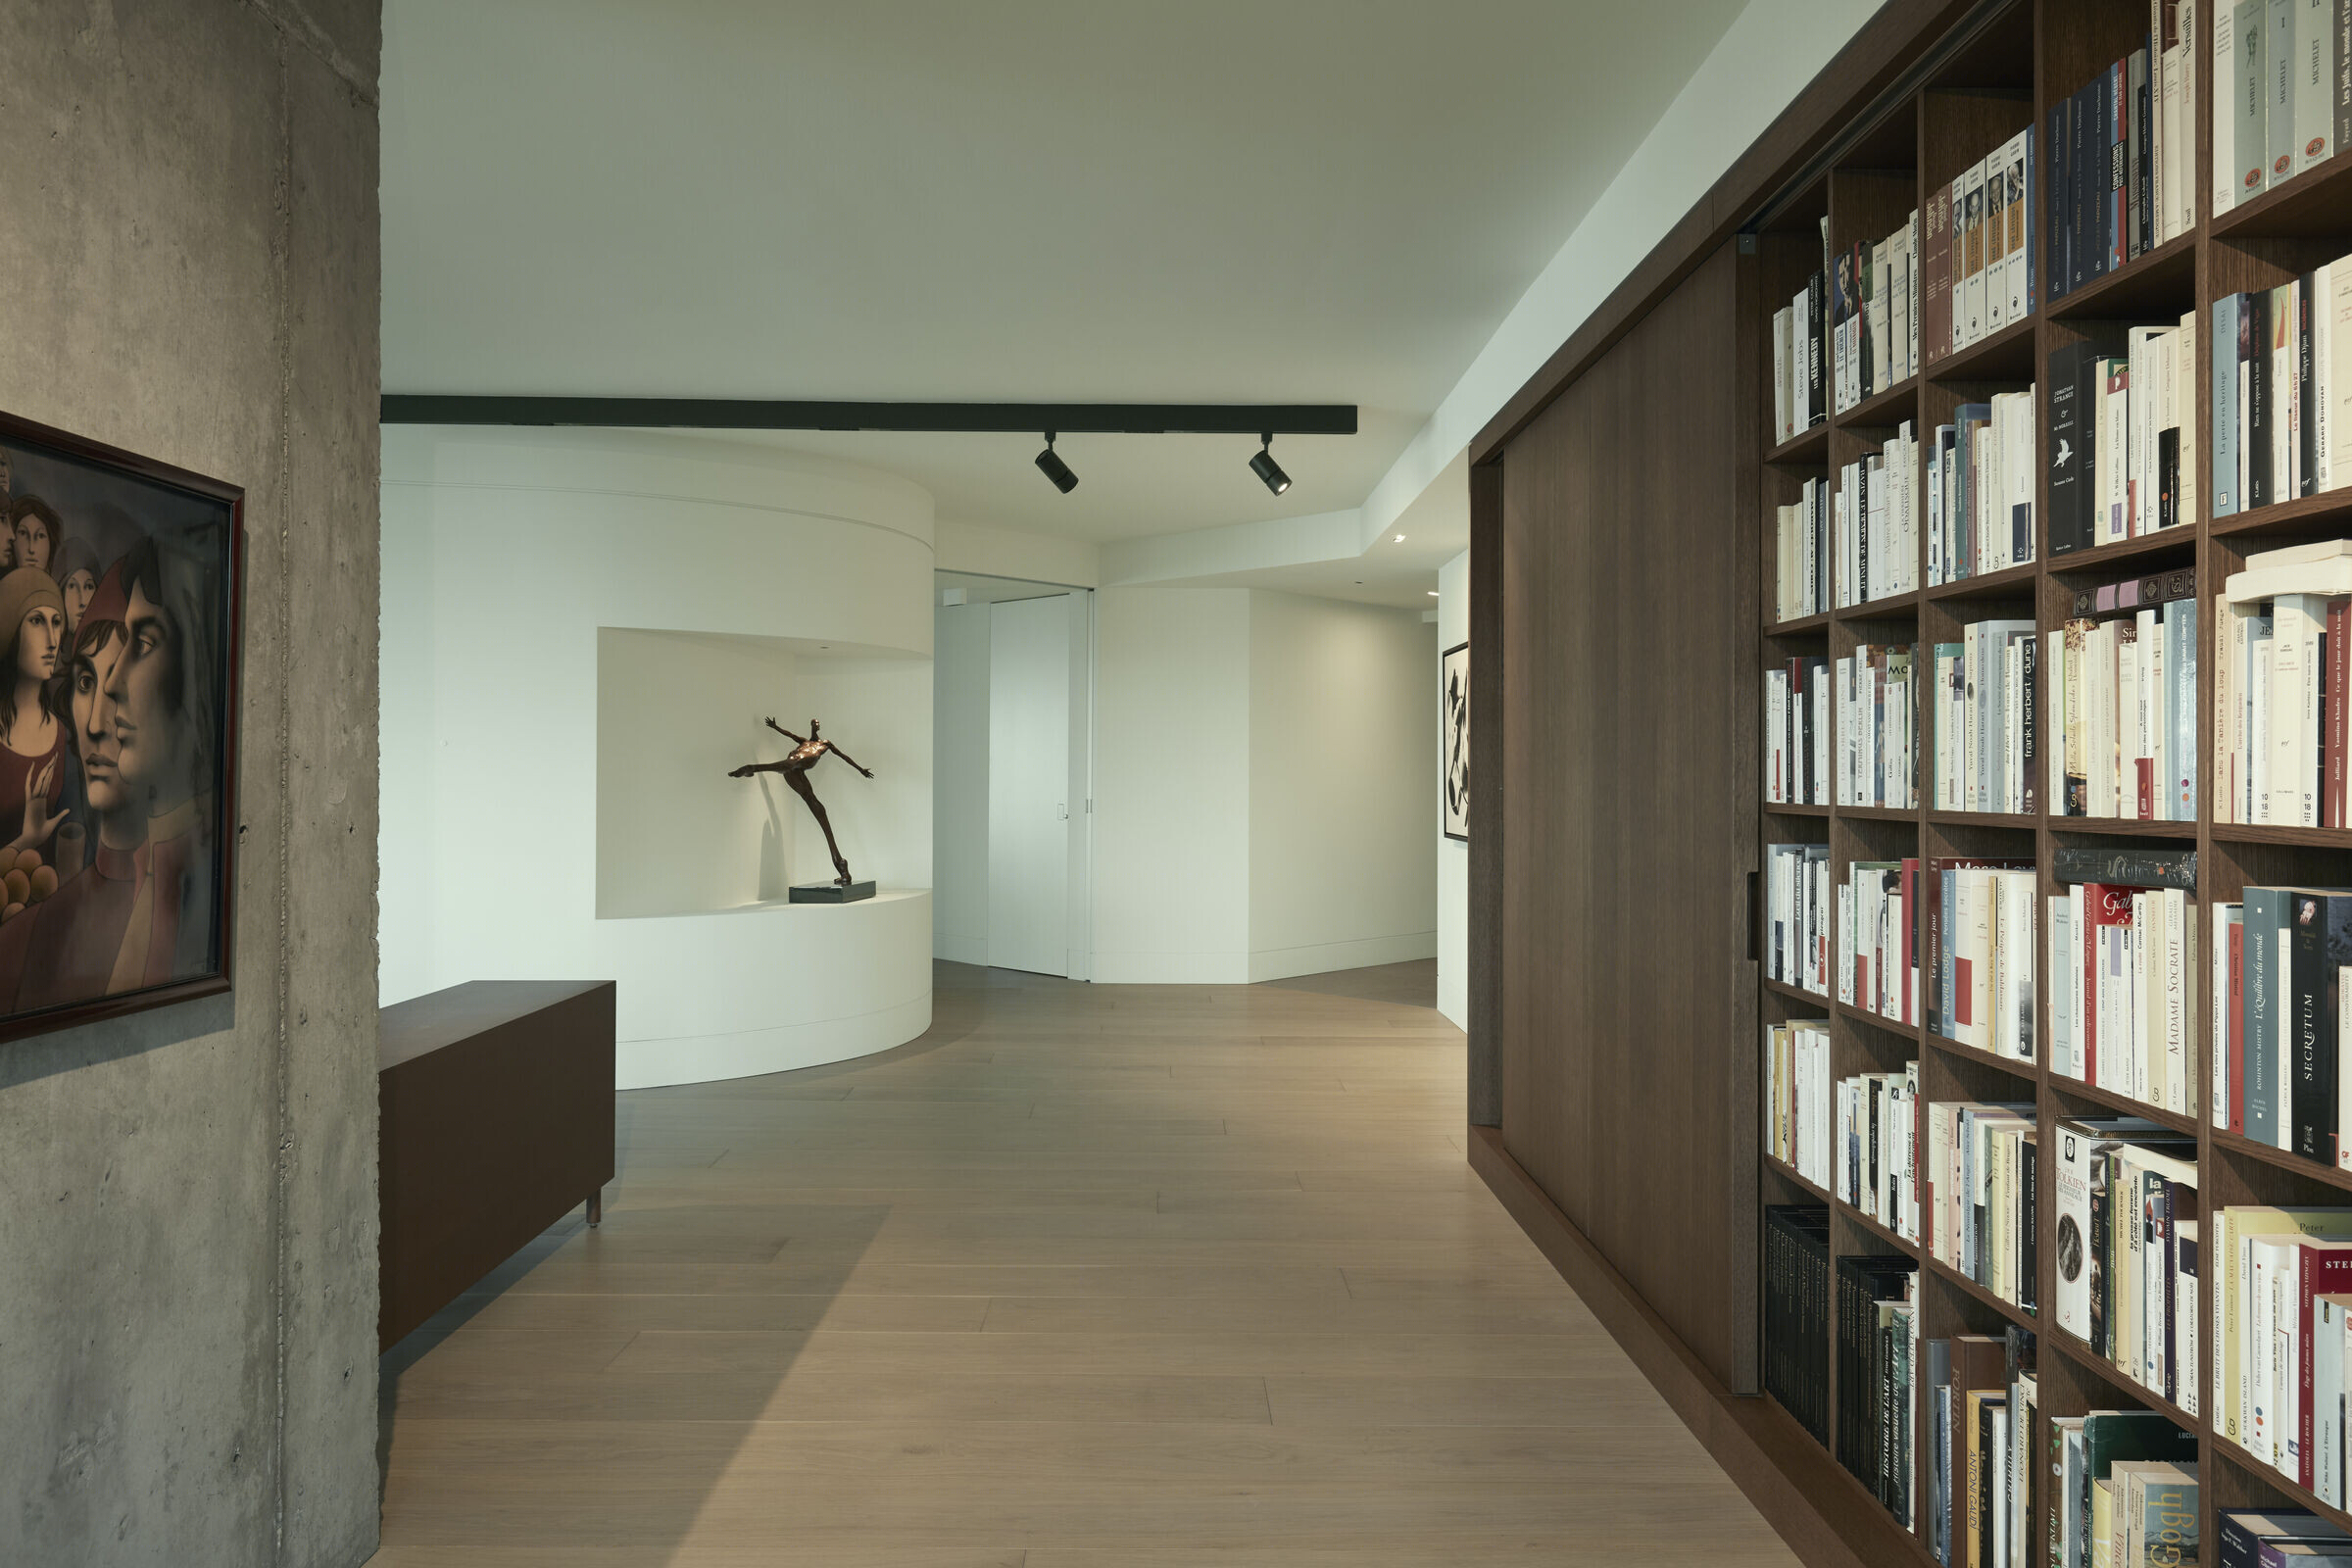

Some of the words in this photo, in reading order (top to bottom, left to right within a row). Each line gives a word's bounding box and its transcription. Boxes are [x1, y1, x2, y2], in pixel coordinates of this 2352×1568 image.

[2182, 7, 2192, 59] Versailles
[2342, 56, 2350, 65] le
[2301, 334, 2310, 354] Djian
[2301, 356, 2310, 382] Philippe
[2054, 391, 2074, 403] STRANGE
[2220, 408, 2228, 417] en
[2220, 443, 2228, 455] La
[2217, 668, 2226, 689] loup
[2335, 684, 2342, 693] Ce
[2024, 682, 2033, 725] herbert
[2217, 693, 2226, 704] du
[2217, 709, 2226, 743] Tanière
[2024, 728, 2033, 758] frank
[2217, 746, 2226, 756] la
[2217, 760, 2226, 780] Dans
[1999, 917, 2005, 927] Le
[2254, 933, 2266, 960] monde
[1942, 945, 1951, 979] Lodge
[2167, 939, 2180, 994] SOCRATE
[2254, 961, 2266, 972] du
[1931, 967, 1937, 978] Le
[1942, 983, 1951, 1015] David
[2254, 973, 2266, 1019] L'éQuilibre
[2167, 998, 2180, 1055] MADAME
[2303, 994, 2315, 1082] SECRETUM
[1907, 1167, 1912, 1178] La
[2056, 1164, 2085, 1192] TOLKIEN
[2299, 1223, 2324, 1232] Peter
[2229, 1281, 2234, 1291] LA
[1892, 1383, 1899, 1396] de
[2215, 1379, 2220, 1390] LE
[1883, 1405, 1889, 1425] DE
[2019, 1415, 2025, 1427] DE
[2148, 1492, 2195, 1568] Gogh
